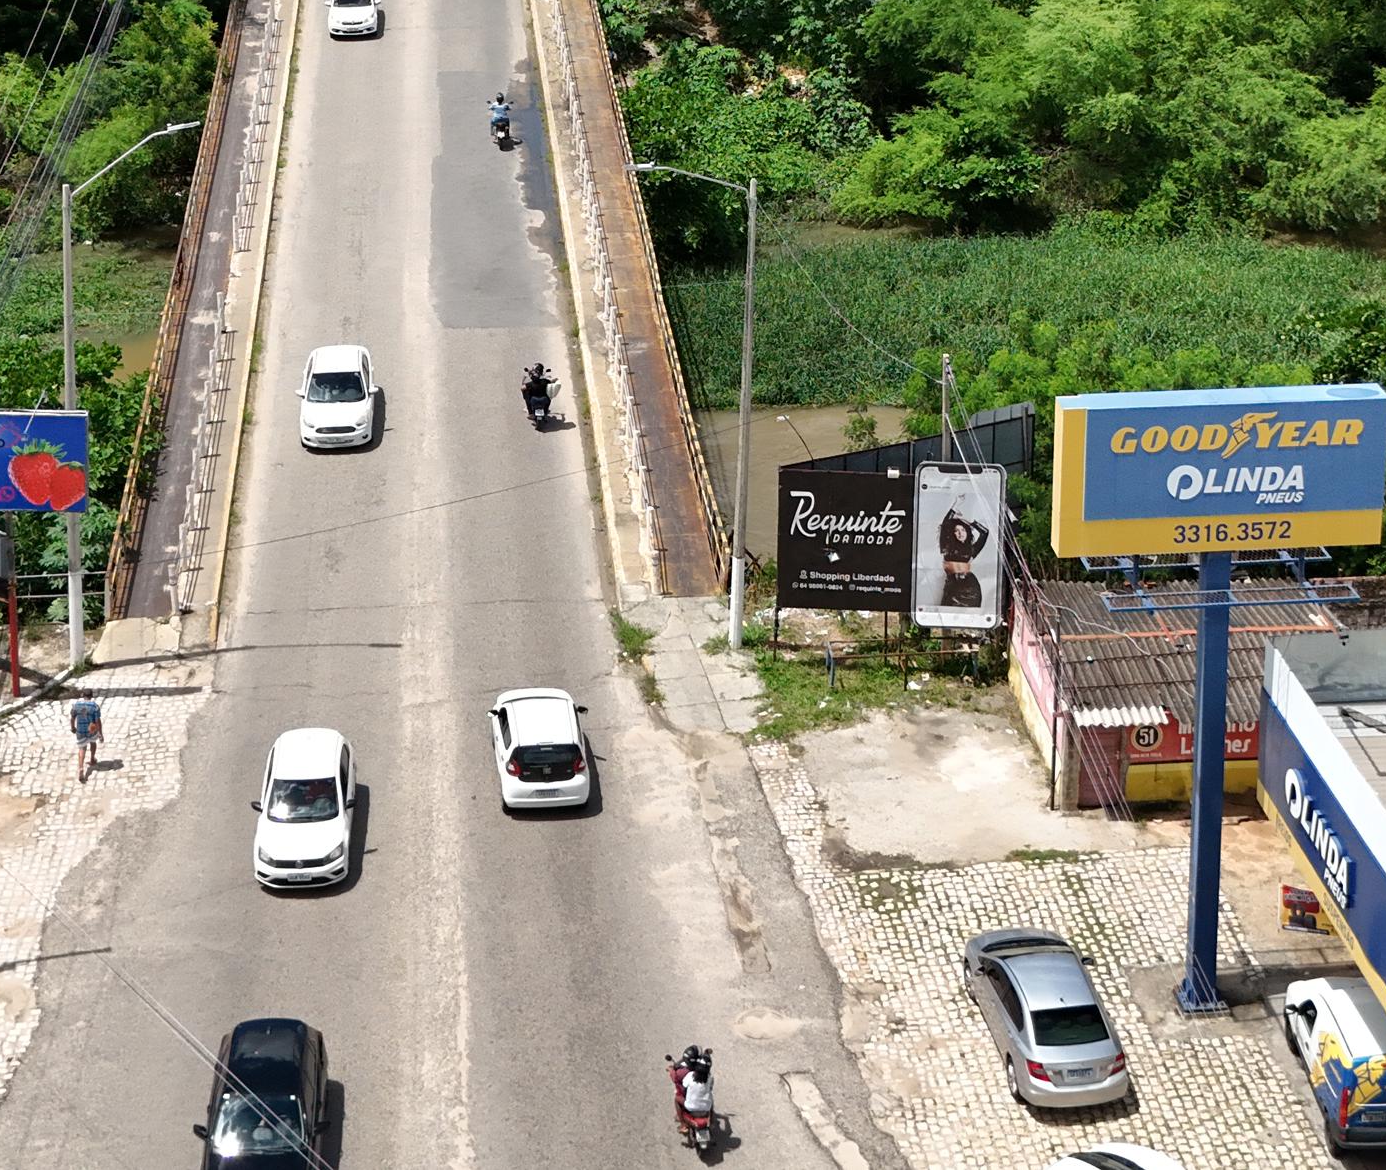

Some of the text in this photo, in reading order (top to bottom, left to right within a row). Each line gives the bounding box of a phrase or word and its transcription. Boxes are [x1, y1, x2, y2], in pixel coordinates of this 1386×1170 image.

[1166, 464, 1305, 501] OLINDA
[1256, 491, 1305, 505] PNEUS
[789, 490, 906, 545] Requinte
[833, 533, 894, 546] DA MODA
[1173, 520, 1293, 545] 3316.3572
[809, 571, 896, 583] Shopping Liberdade
[1139, 731, 1155, 745] 51
[1284, 768, 1349, 895] OLINDA
[1323, 867, 1348, 911] PNEUS
